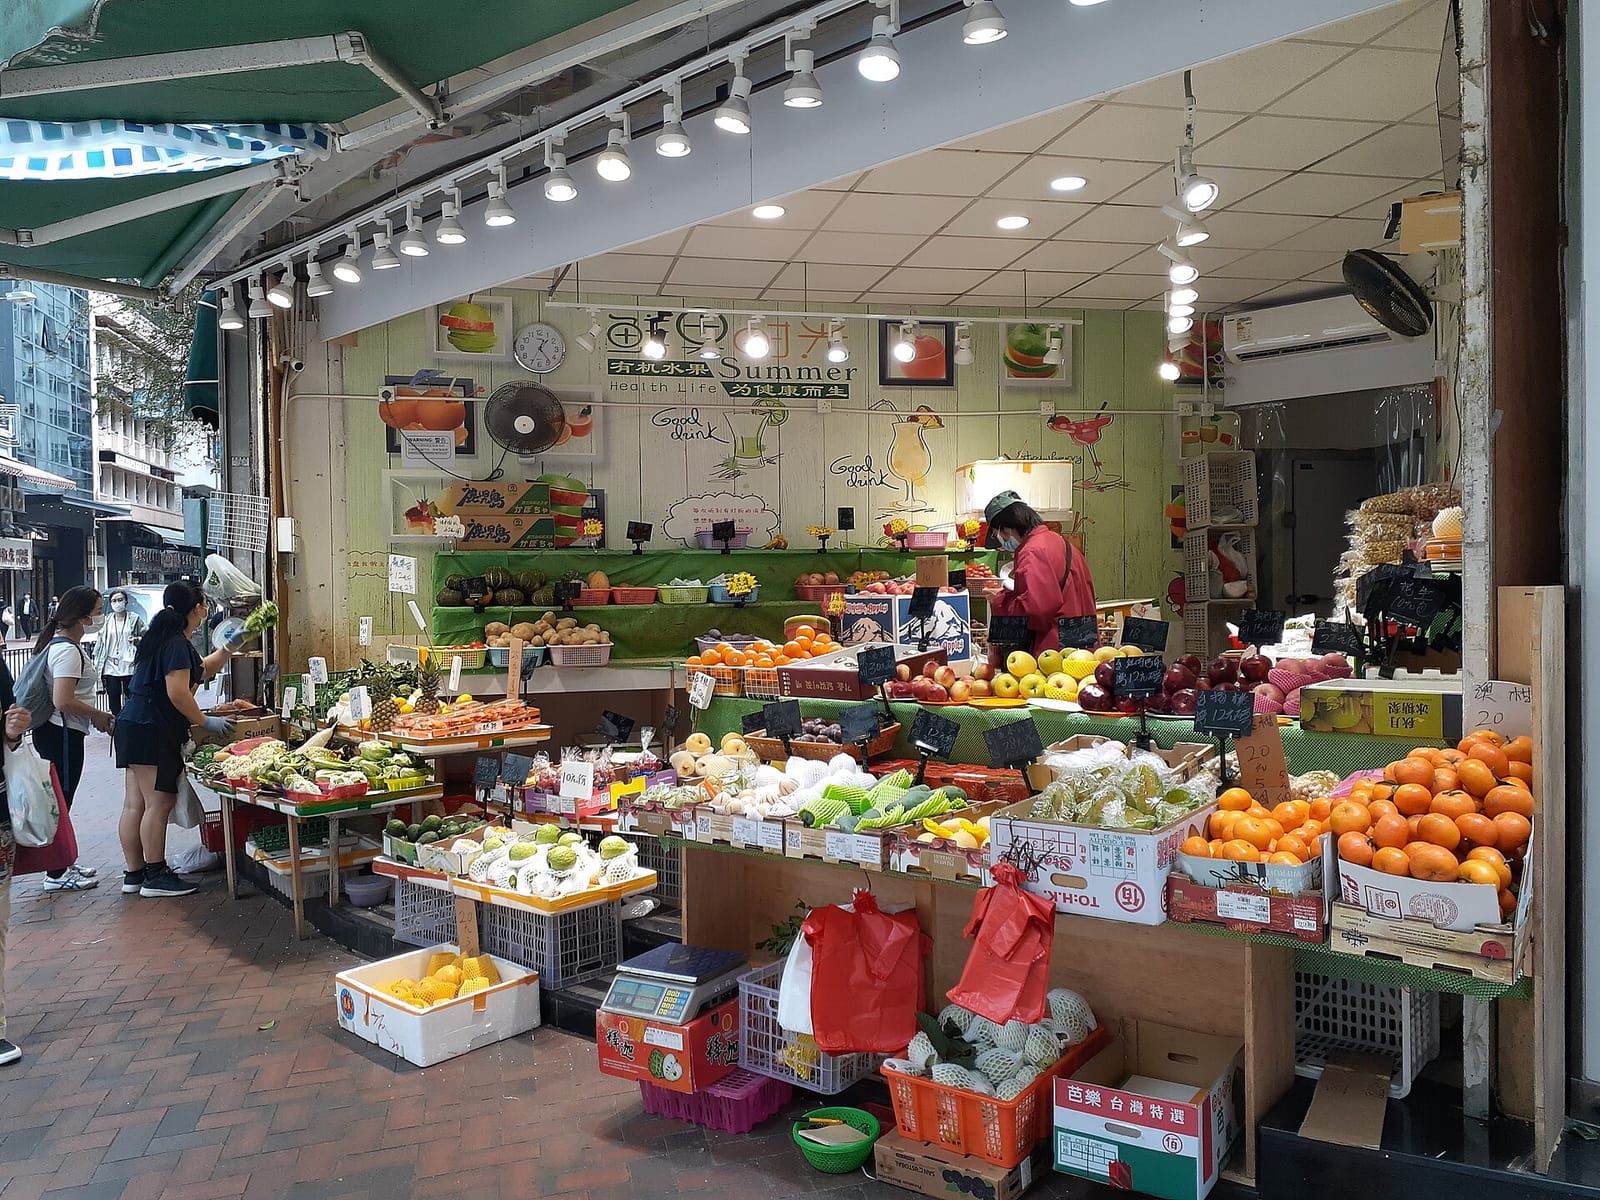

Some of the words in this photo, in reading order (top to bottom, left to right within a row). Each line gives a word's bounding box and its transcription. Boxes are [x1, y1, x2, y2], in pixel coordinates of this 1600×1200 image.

[609, 360, 710, 376] 有机水果
[718, 357, 857, 381] Summer
[610, 381, 668, 392] Health
[678, 383, 717, 393] Life
[731, 383, 848, 397] 为健康而生
[651, 407, 704, 427] Good
[670, 421, 730, 443] drink
[829, 454, 876, 475] Good
[846, 469, 900, 490] drink
[942, 638, 964, 656] Apples
[1388, 702, 1429, 715] 冰糖梨
[1390, 717, 1415, 728] 秋月
[1475, 710, 1504, 727] 20
[245, 725, 275, 739] Sweet
[1043, 890, 1100, 908] TO:H.K.
[1067, 1085, 1101, 1108] 芭樂
[1110, 1096, 1185, 1125] 台灣特選
